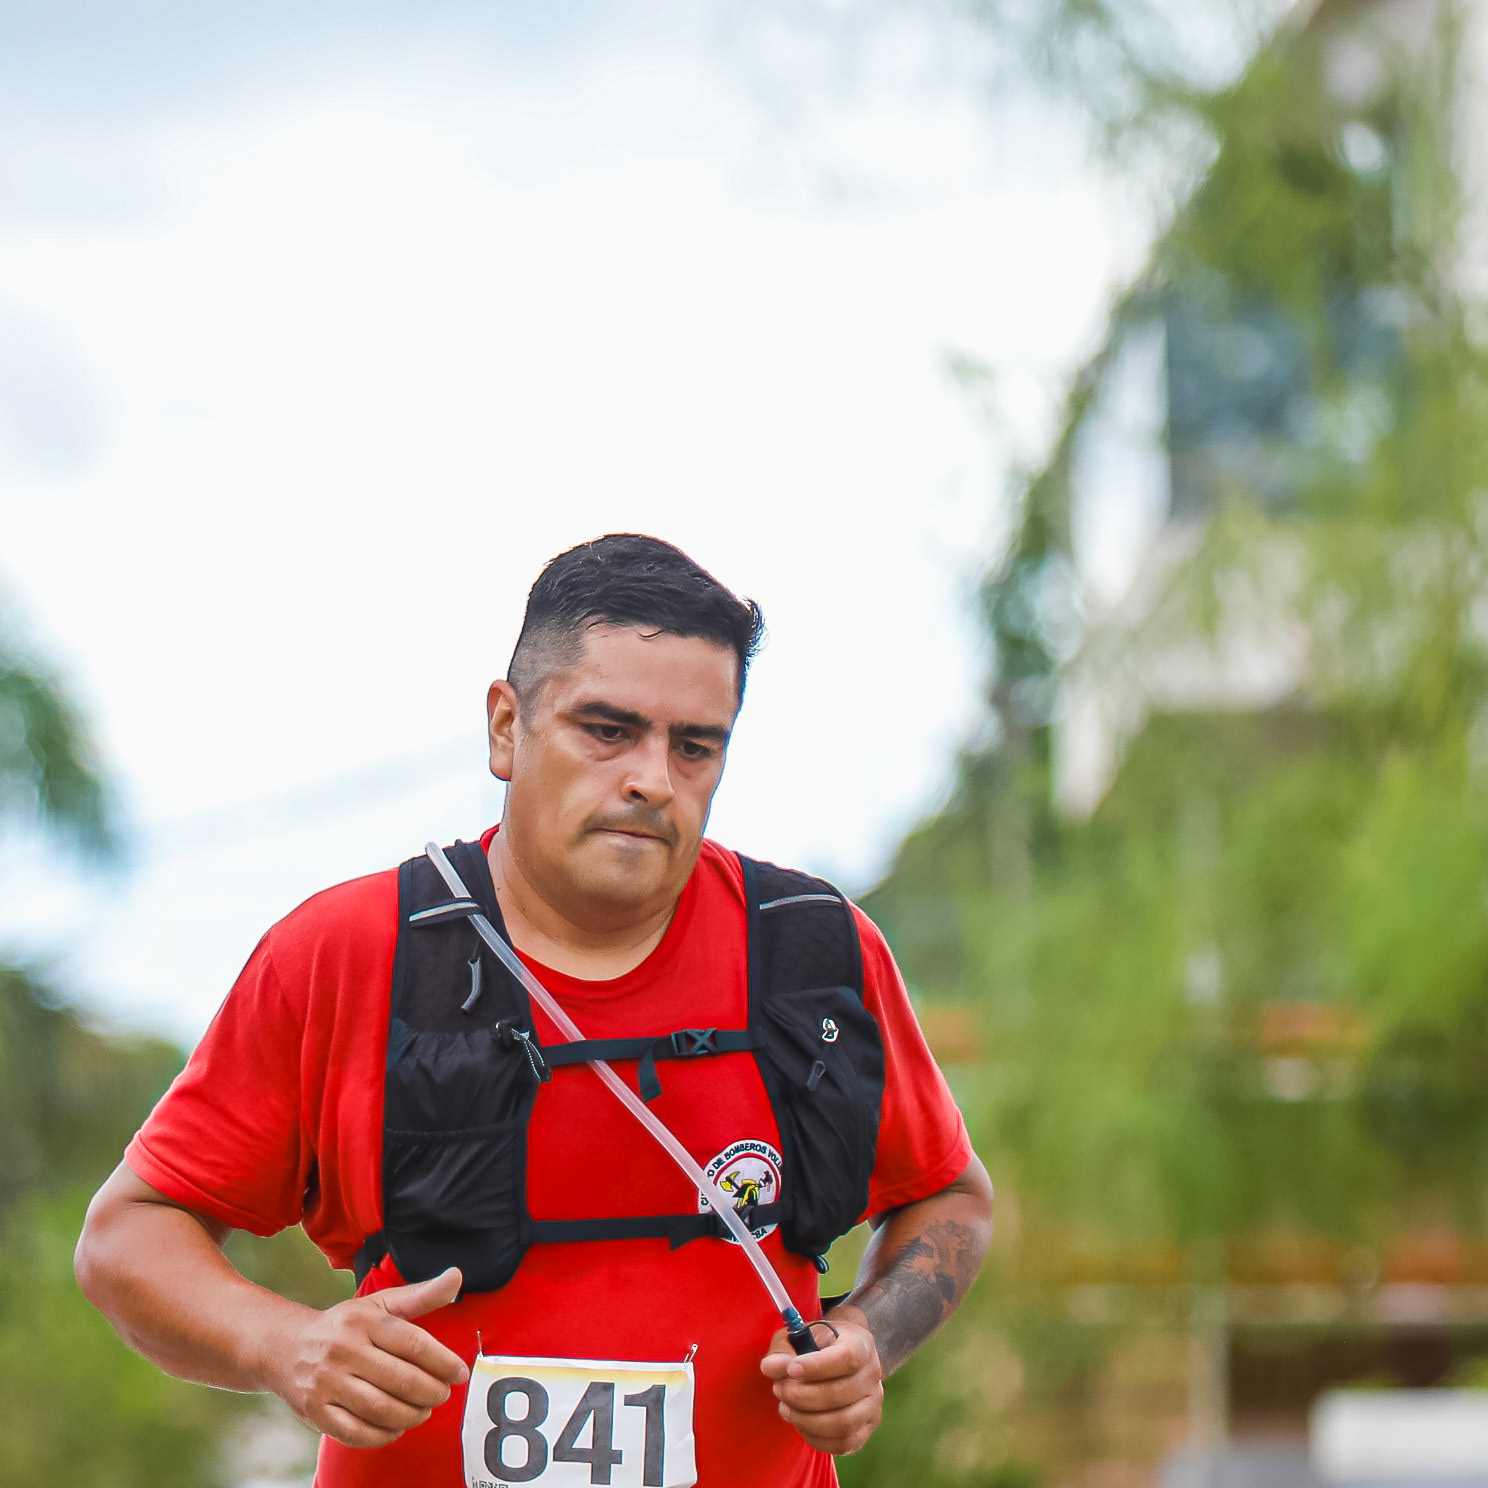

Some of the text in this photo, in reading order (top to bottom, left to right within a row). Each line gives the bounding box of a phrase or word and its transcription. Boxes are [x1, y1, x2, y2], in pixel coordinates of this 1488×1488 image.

[712, 1157, 725, 1170] DE
[724, 1142, 767, 1159] BOMBEROS
[483, 1376, 666, 1488] 841
